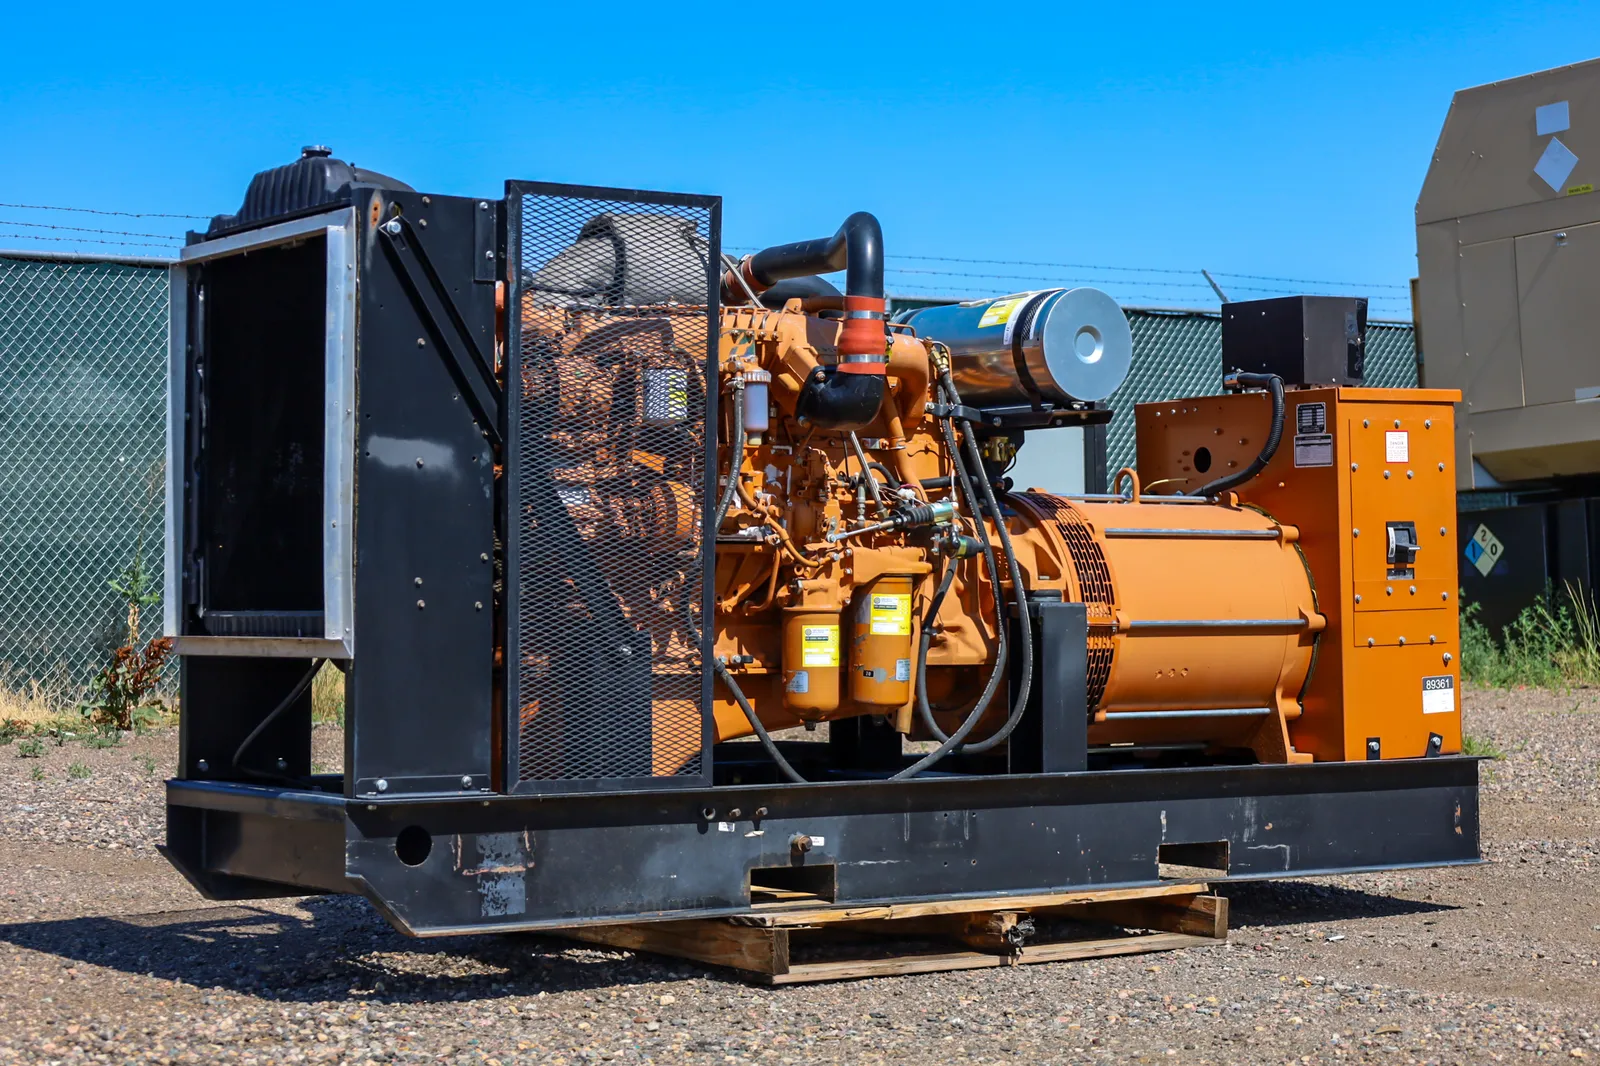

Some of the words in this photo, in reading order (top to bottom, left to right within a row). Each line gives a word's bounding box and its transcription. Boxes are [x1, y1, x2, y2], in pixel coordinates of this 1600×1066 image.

[1481, 528, 1487, 542] 2
[1471, 543, 1476, 559] 1
[1490, 543, 1498, 556] 0
[1425, 678, 1450, 690] 89361
